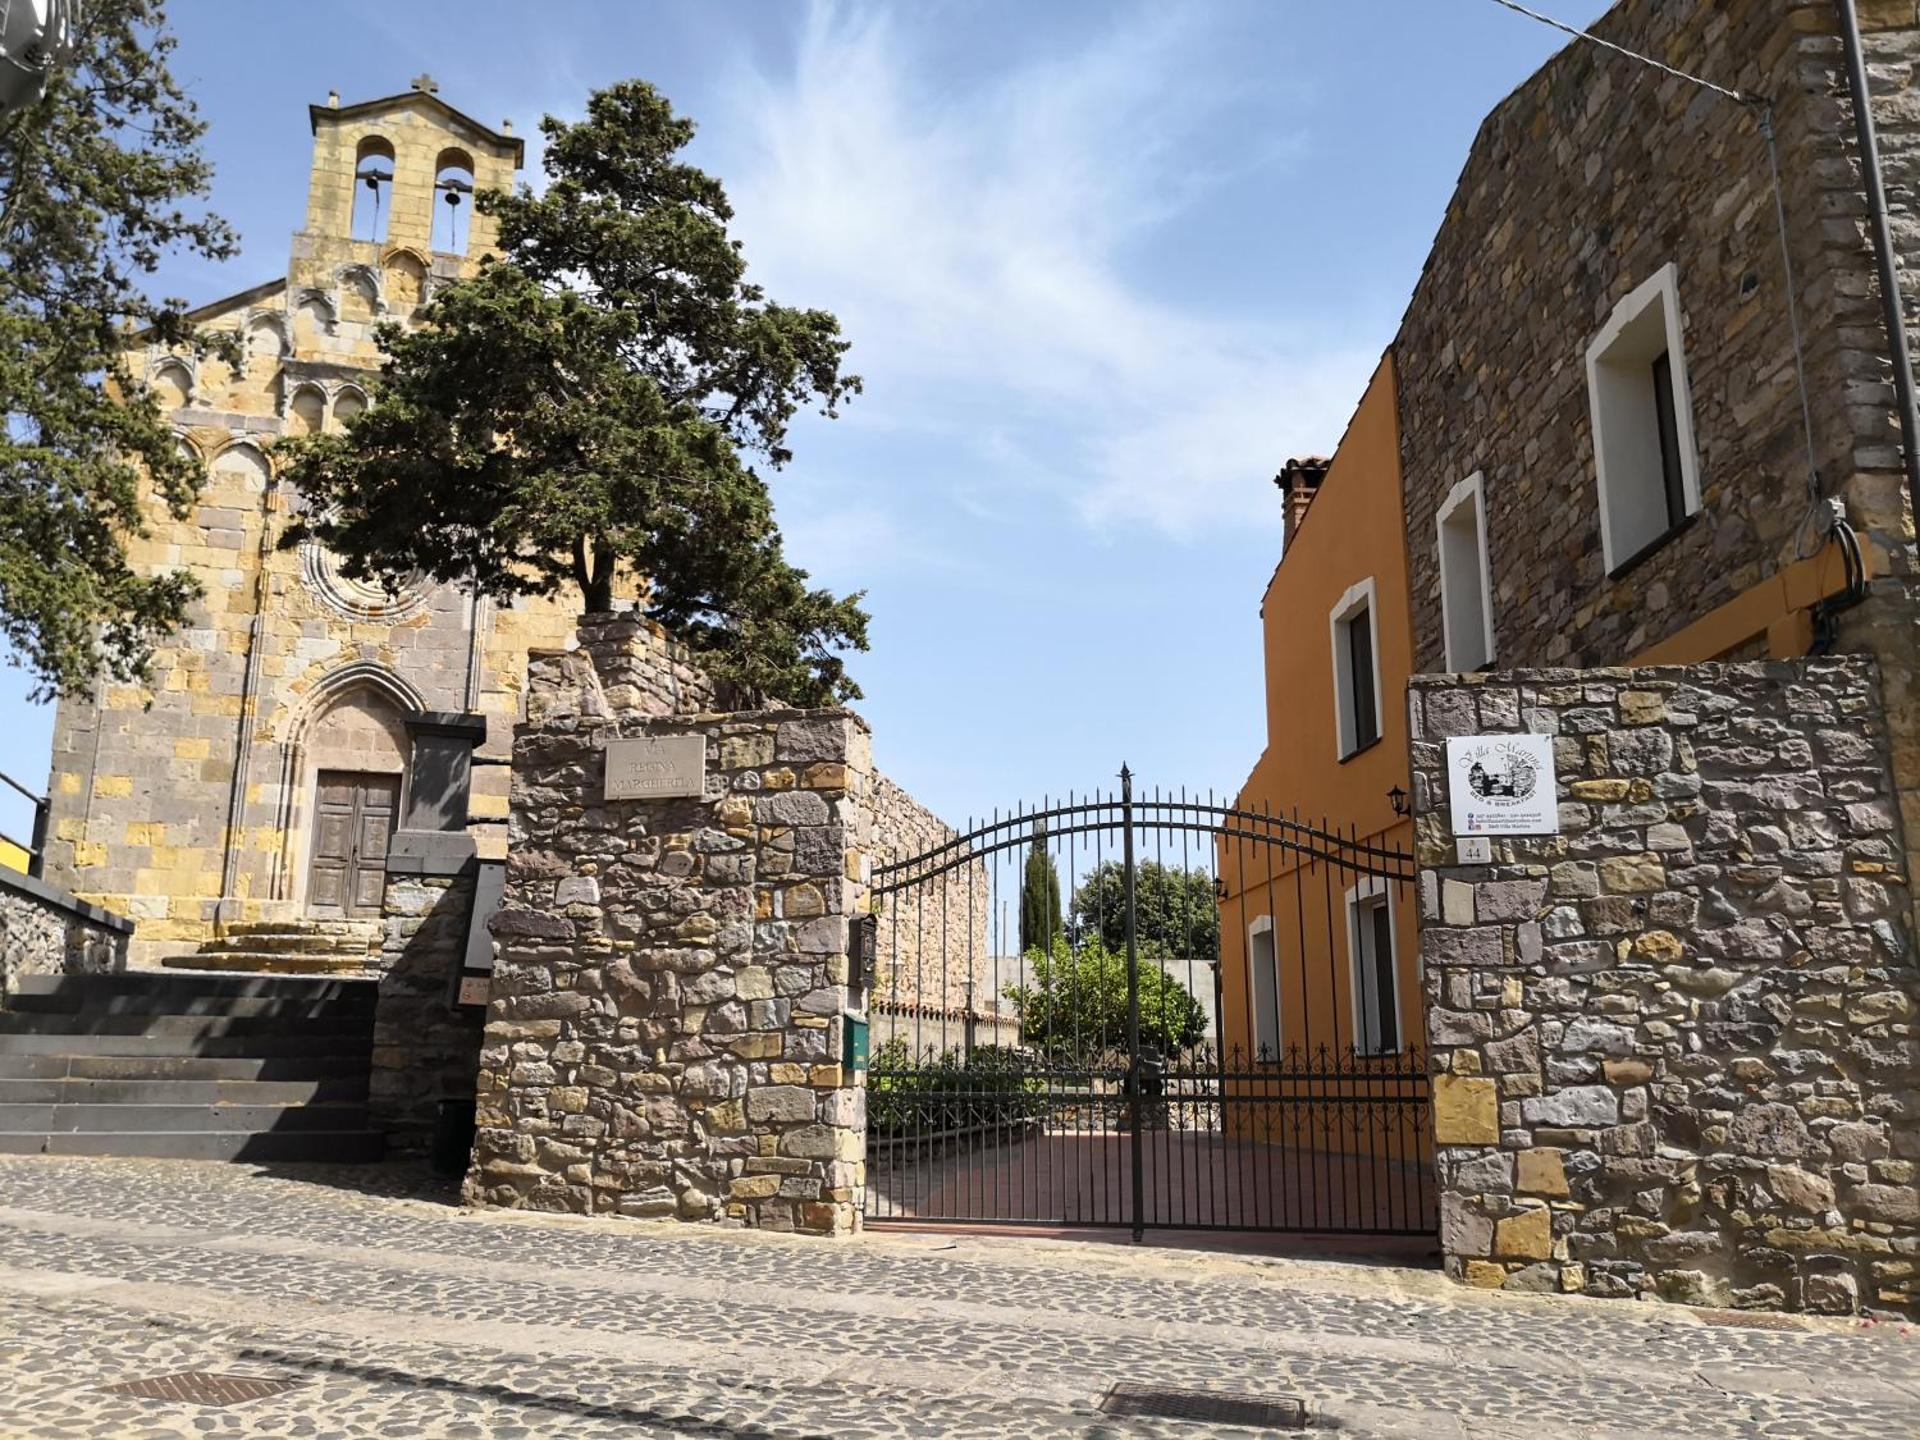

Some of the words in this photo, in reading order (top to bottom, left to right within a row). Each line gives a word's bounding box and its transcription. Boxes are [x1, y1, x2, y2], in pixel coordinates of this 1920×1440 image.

[644, 744, 665, 755] VIA
[630, 760, 676, 773] REGINA
[613, 777, 696, 790] MARGHERITA
[1470, 790, 1484, 802] BED
[1495, 789, 1537, 807] BREAKFAST
[1466, 848, 1481, 859] 44
